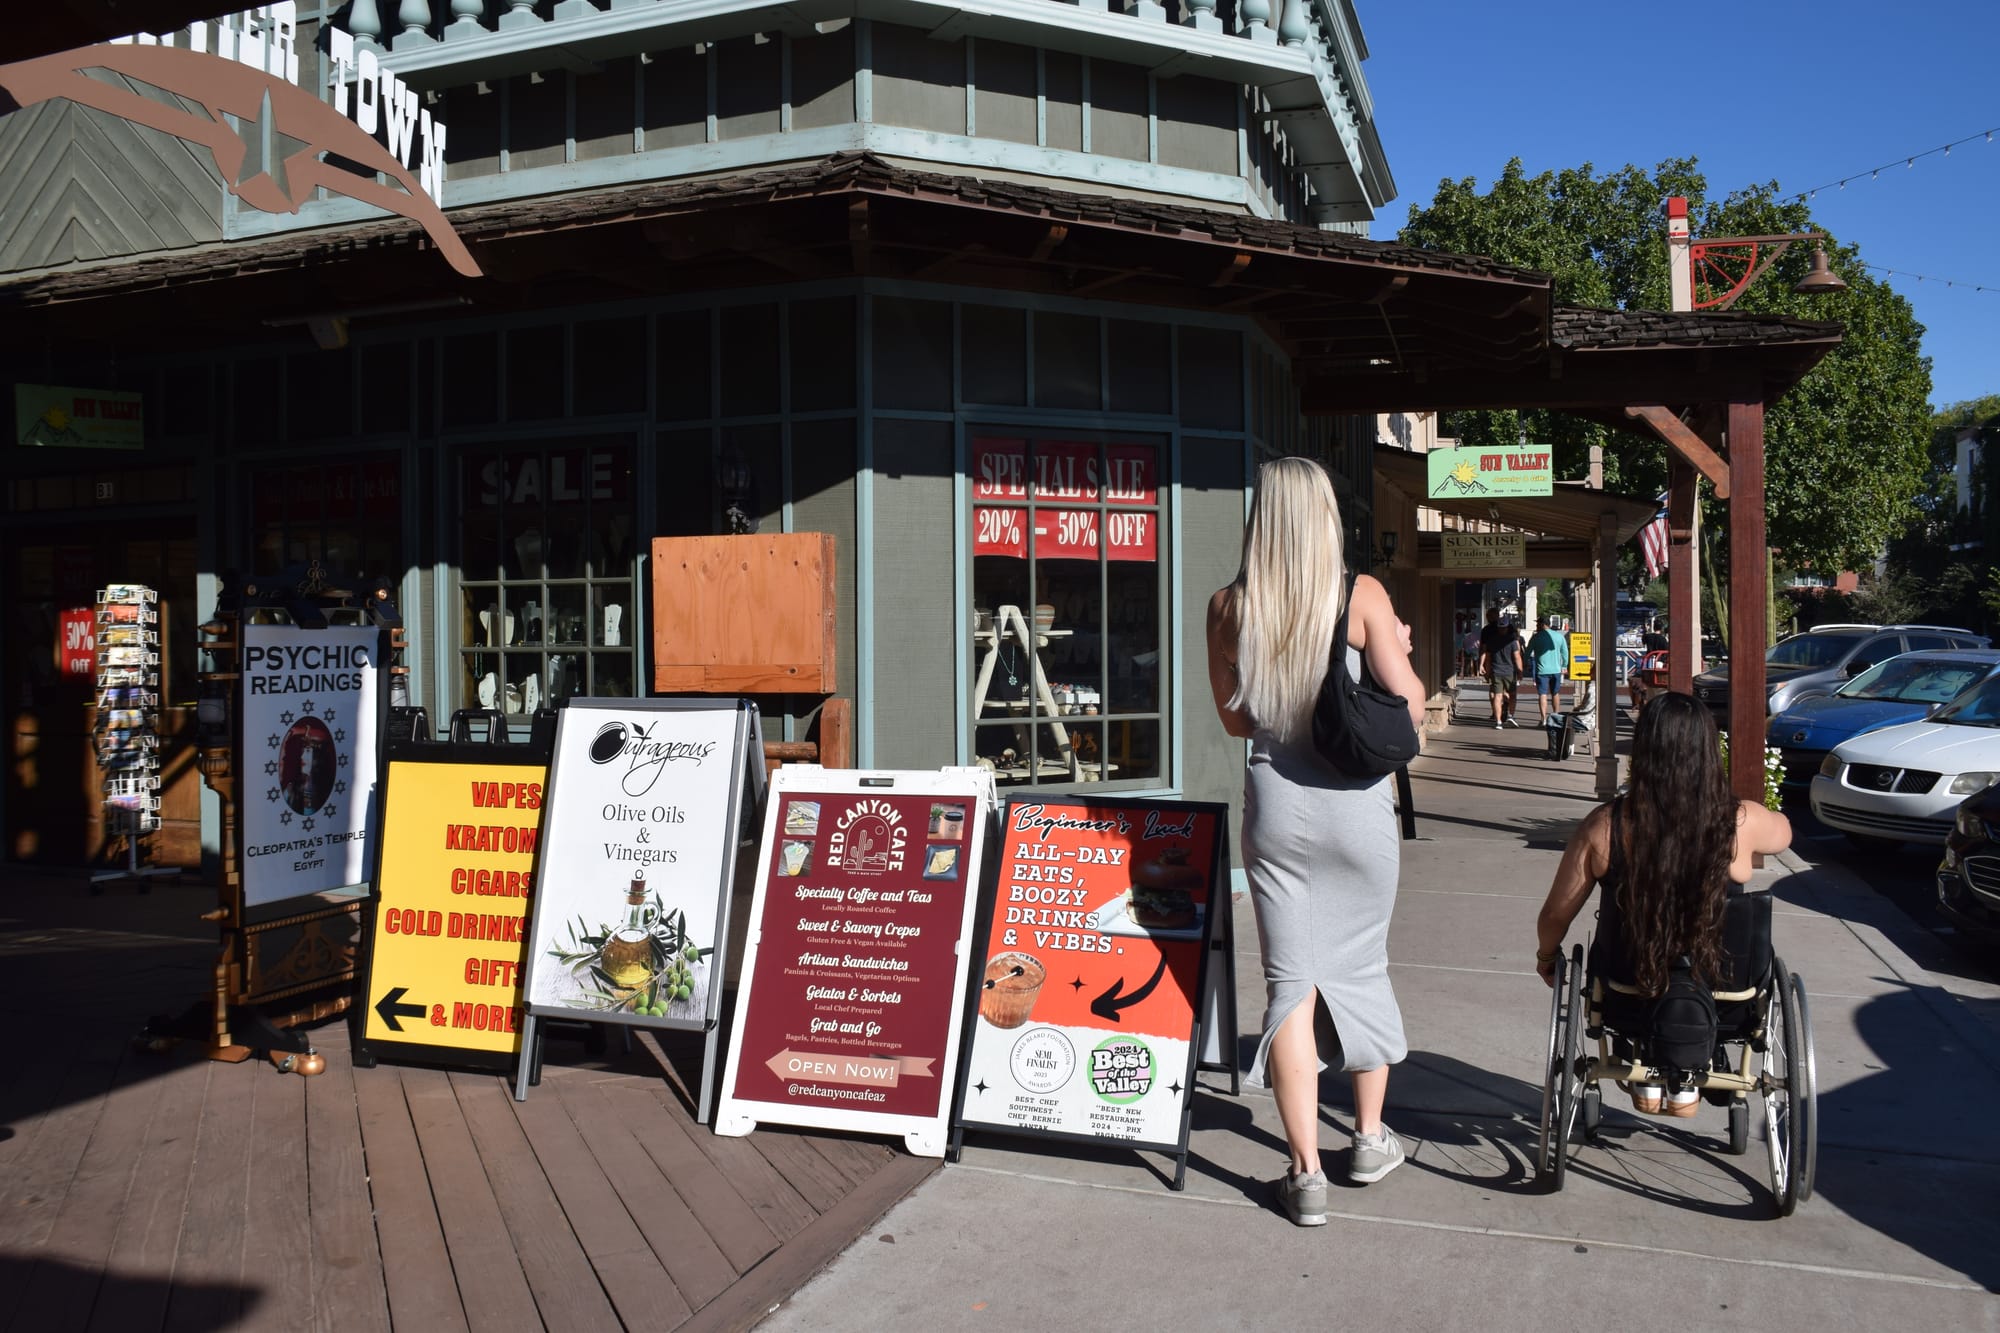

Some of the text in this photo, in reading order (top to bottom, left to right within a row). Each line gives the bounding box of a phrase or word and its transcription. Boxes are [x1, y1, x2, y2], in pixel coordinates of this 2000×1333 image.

[330, 25, 447, 211] TOWN
[1480, 453, 1550, 471] SUN VALLEY
[480, 453, 613, 505] SALE
[978, 509, 1020, 545] 20%
[1058, 512, 1097, 547] 50%
[1109, 513, 1148, 547] OFF
[1446, 536, 1520, 547] SUNRISE
[1451, 549, 1491, 558] Trading
[66, 621, 95, 650] 50%
[244, 645, 369, 672] PSYCHIC
[251, 673, 363, 695] READINGS
[588, 720, 717, 797] Outrageous
[471, 781, 542, 810] VAPES
[602, 803, 685, 823] Olive Oils
[1013, 803, 1197, 841] Beginner's Luck
[247, 830, 367, 857] CLEOPATRA'S TEMPLE
[445, 824, 538, 854] KRATOM
[636, 827, 650, 844] &
[827, 799, 908, 871] RED CANYON CAFE
[303, 850, 316, 859] OF
[604, 843, 678, 867] Vinegars
[1014, 842, 1126, 866] ALL-DAY
[294, 858, 325, 871] EGYPT
[451, 868, 533, 899] CIGARS
[1011, 863, 1086, 889] EATS,
[795, 884, 933, 904] Specialty Coffee and Teas
[1008, 884, 1088, 907] BOOZY
[822, 904, 897, 914] Locally Roasted Coffee
[1005, 906, 1100, 930] DRINKS
[385, 908, 530, 943] COLD DRINKS
[797, 918, 921, 939] Sweet & Savory Crepes
[806, 936, 829, 944] Gluten
[830, 937, 846, 945] Free
[853, 939, 874, 948] Vegan
[875, 940, 908, 949] Available
[1002, 929, 1125, 955] & VIBES.
[798, 952, 909, 971] Artisan Sandwiches
[464, 957, 525, 988] GIFTS
[809, 968, 815, 976] &
[854, 971, 892, 981] Vegetarian
[892, 974, 920, 983] Options
[806, 984, 902, 1004] Gelatos & Sorbets
[430, 1003, 448, 1028] &
[814, 1003, 883, 1015] Local Chef Prepared
[810, 1017, 882, 1038] Grab and Go
[841, 1037, 869, 1046] Bottled
[867, 1039, 902, 1050] Beverages
[1114, 1045, 1138, 1054] 2024
[1026, 1058, 1059, 1070] FINALIST
[1034, 1049, 1052, 1060] SEMI
[1092, 1048, 1150, 1071] Best
[788, 1058, 894, 1080] OPEN NOW!
[1107, 1068, 1138, 1080] of the
[788, 1083, 886, 1102] @redcanyoncafeaz
[1092, 1077, 1151, 1096] Valley
[1009, 1103, 1054, 1114] SOUTHWEST
[1015, 1096, 1060, 1106] BEST CHEF
[1007, 1112, 1062, 1125] CHEF BERNIE
[1126, 1107, 1142, 1116] NEW
[1091, 1122, 1111, 1130] 2024
[1126, 1126, 1142, 1134] PHX
